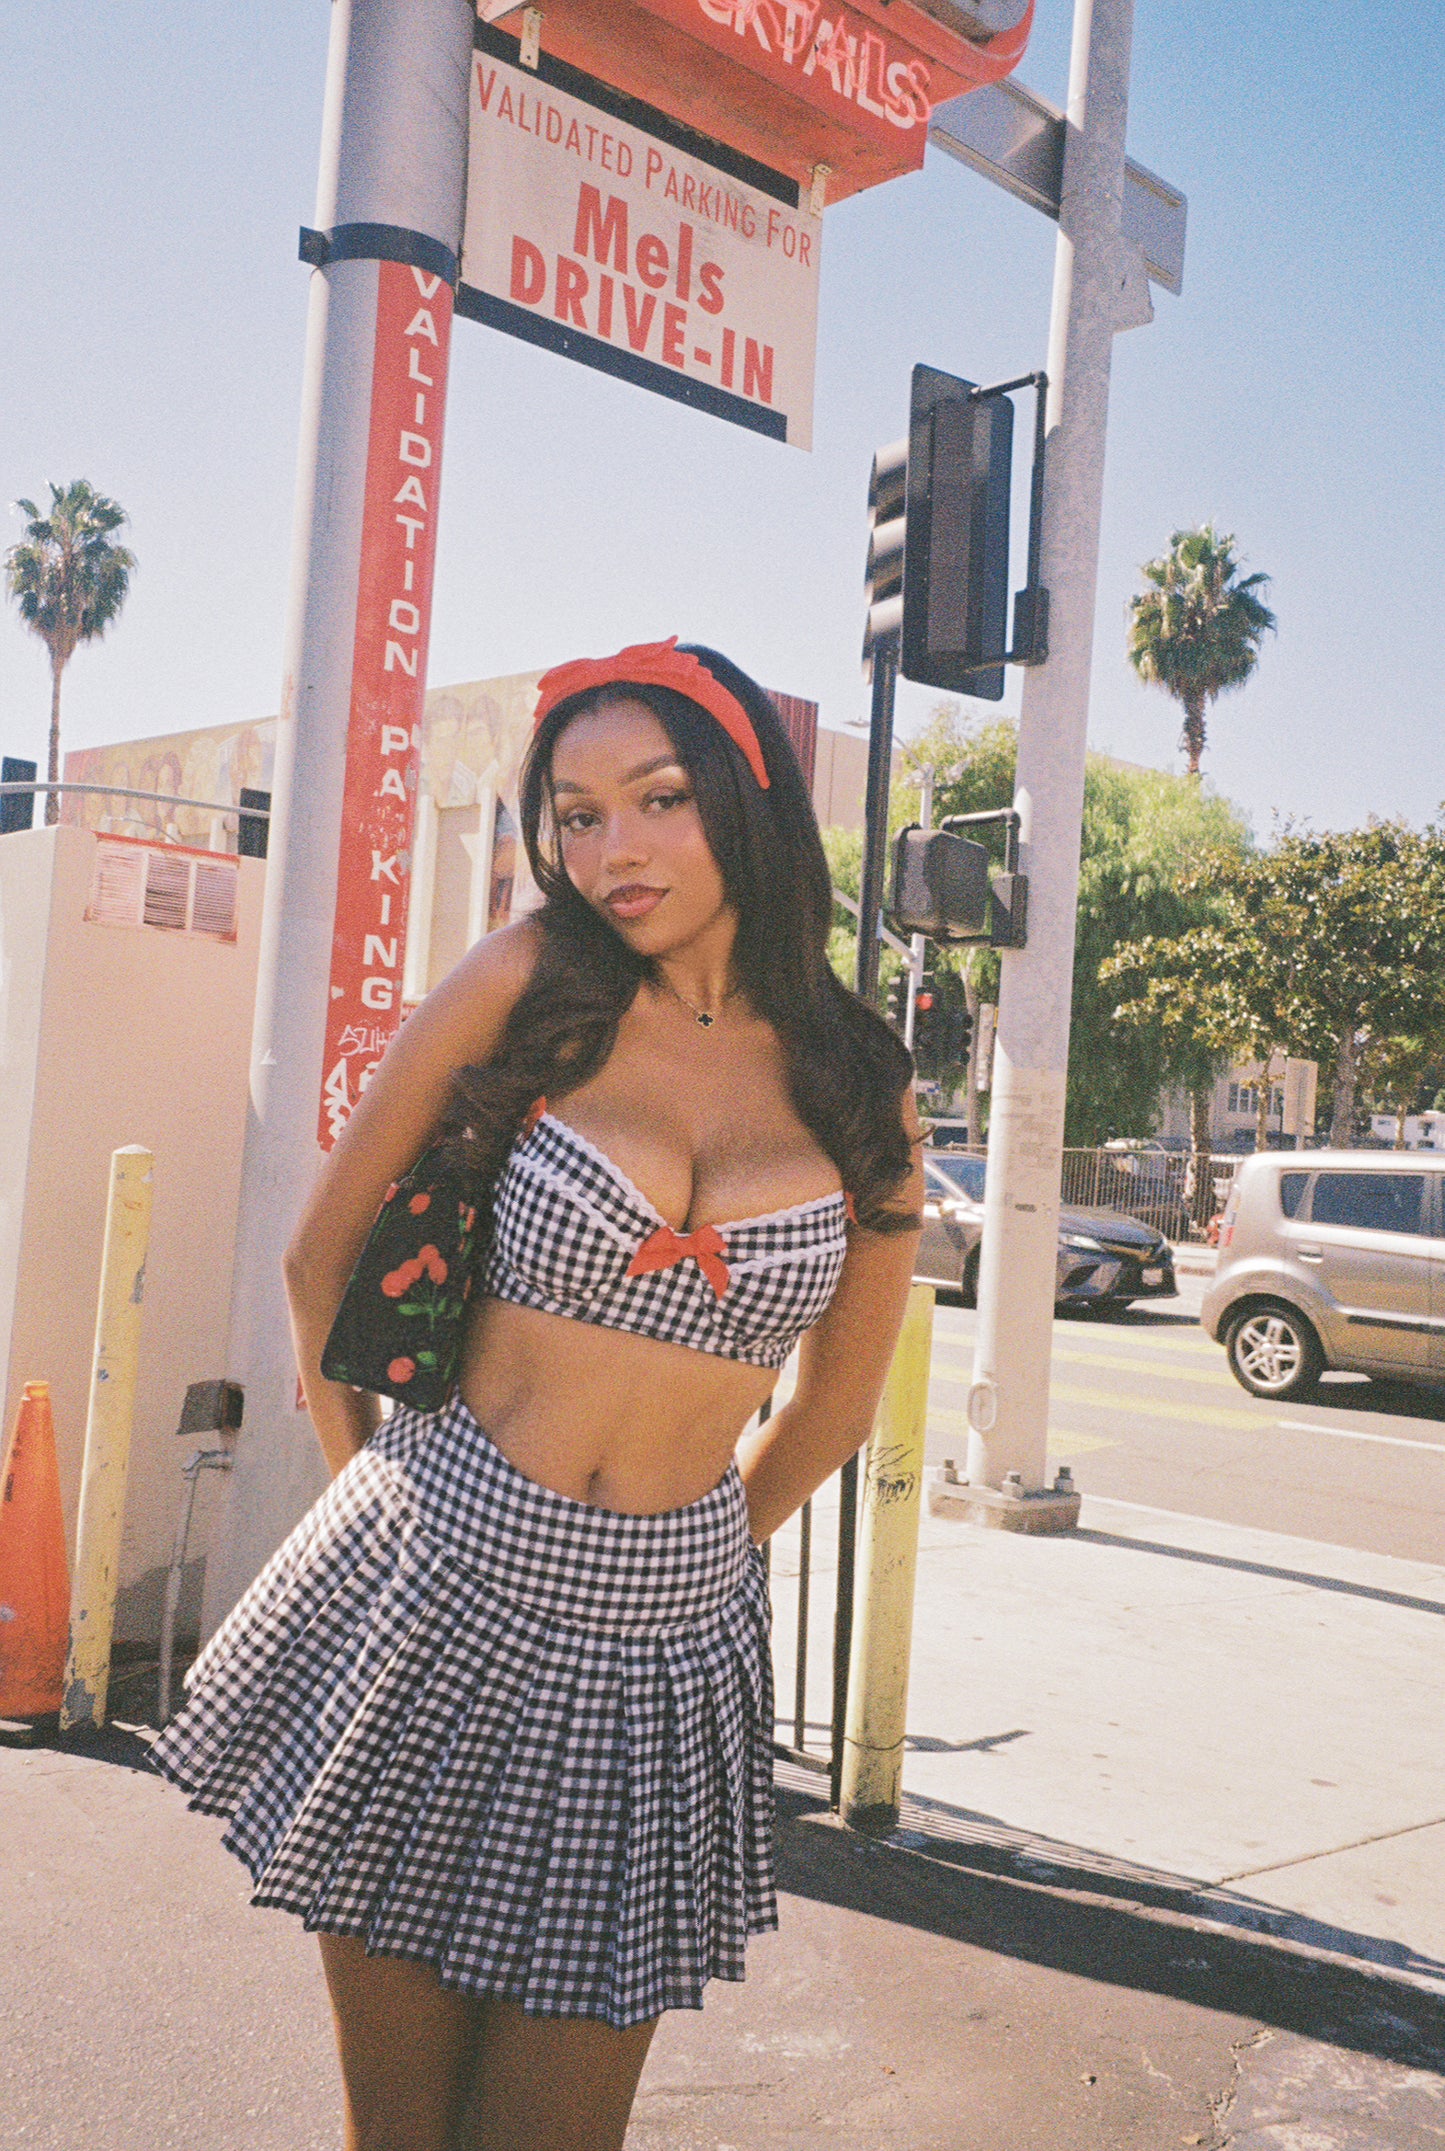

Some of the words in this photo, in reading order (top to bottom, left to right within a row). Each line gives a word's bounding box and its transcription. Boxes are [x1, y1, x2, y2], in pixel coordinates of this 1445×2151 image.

[476, 62, 633, 178] VALIDATED
[645, 147, 756, 239] PARKING
[767, 208, 811, 268] FOR
[573, 181, 725, 316] Mels
[510, 235, 774, 404] DRIVE-IN
[383, 265, 443, 677] VALIDATION
